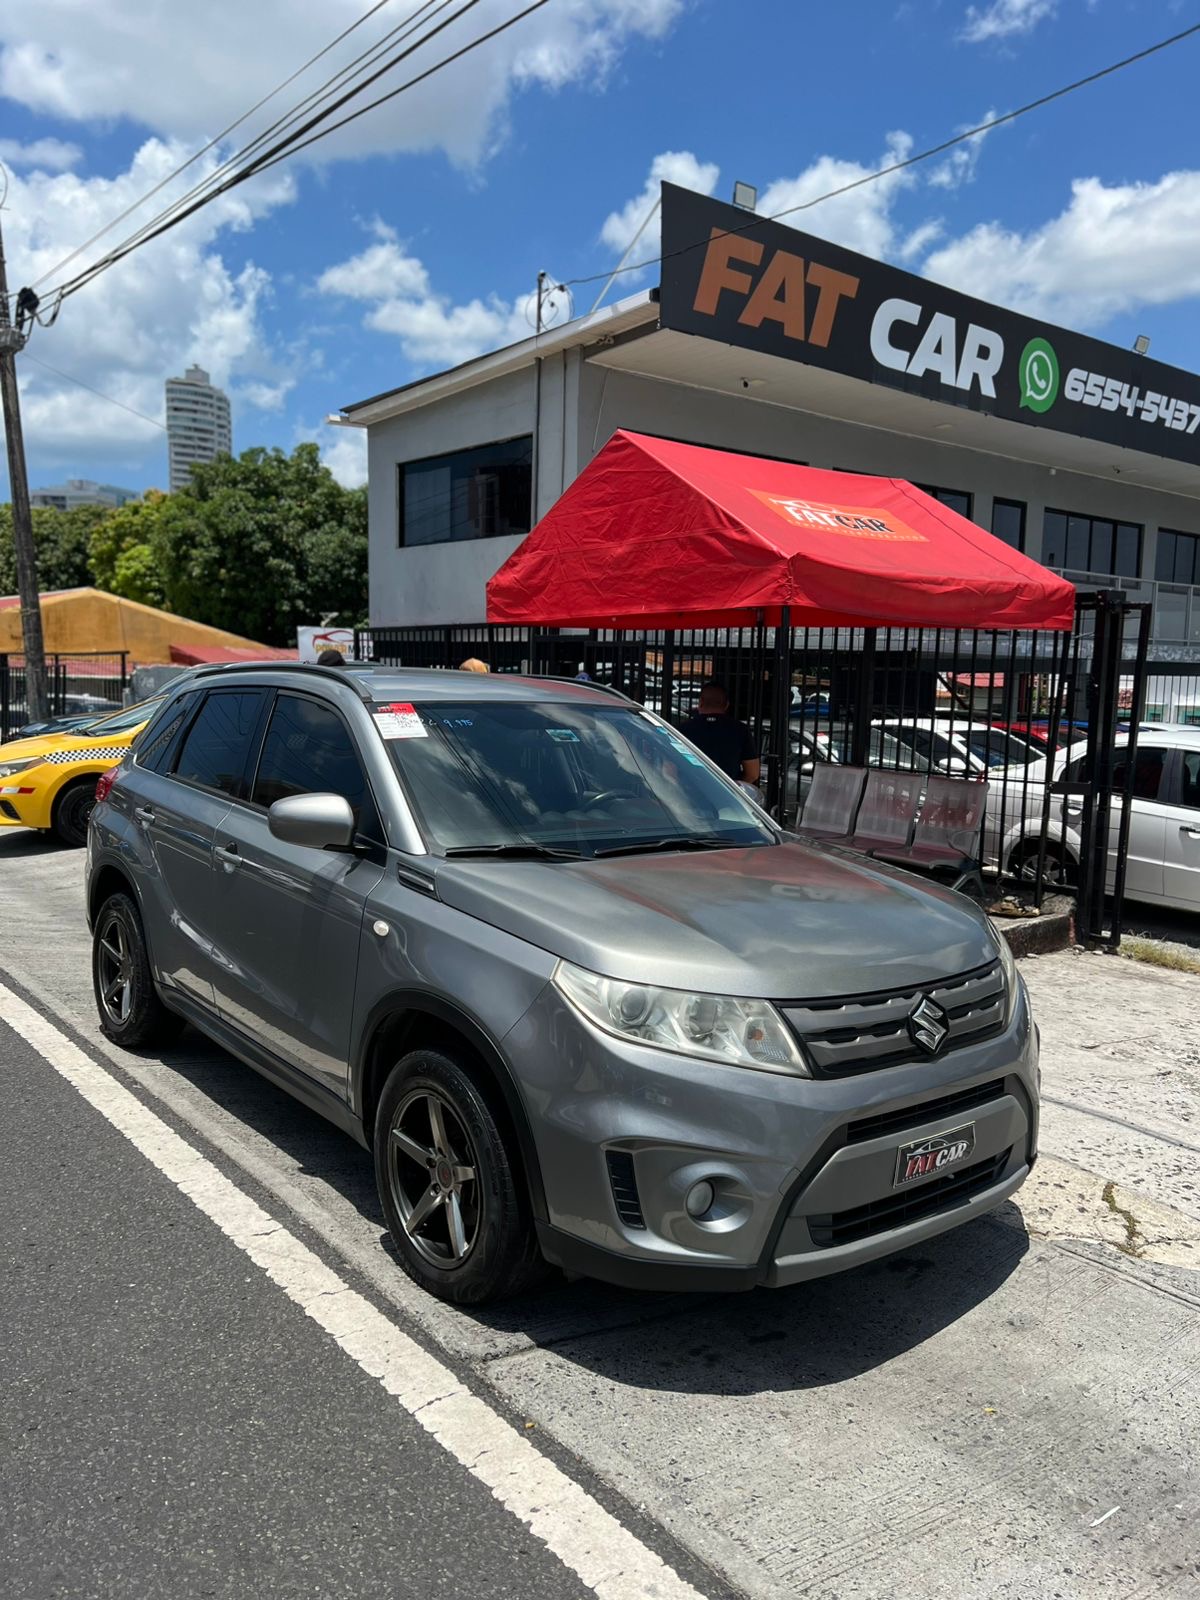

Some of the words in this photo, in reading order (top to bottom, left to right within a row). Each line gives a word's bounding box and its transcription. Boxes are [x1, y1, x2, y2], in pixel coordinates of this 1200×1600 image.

[693, 227, 860, 348] FAT
[870, 298, 1004, 398] CAR
[1064, 367, 1200, 435] 6554-5437
